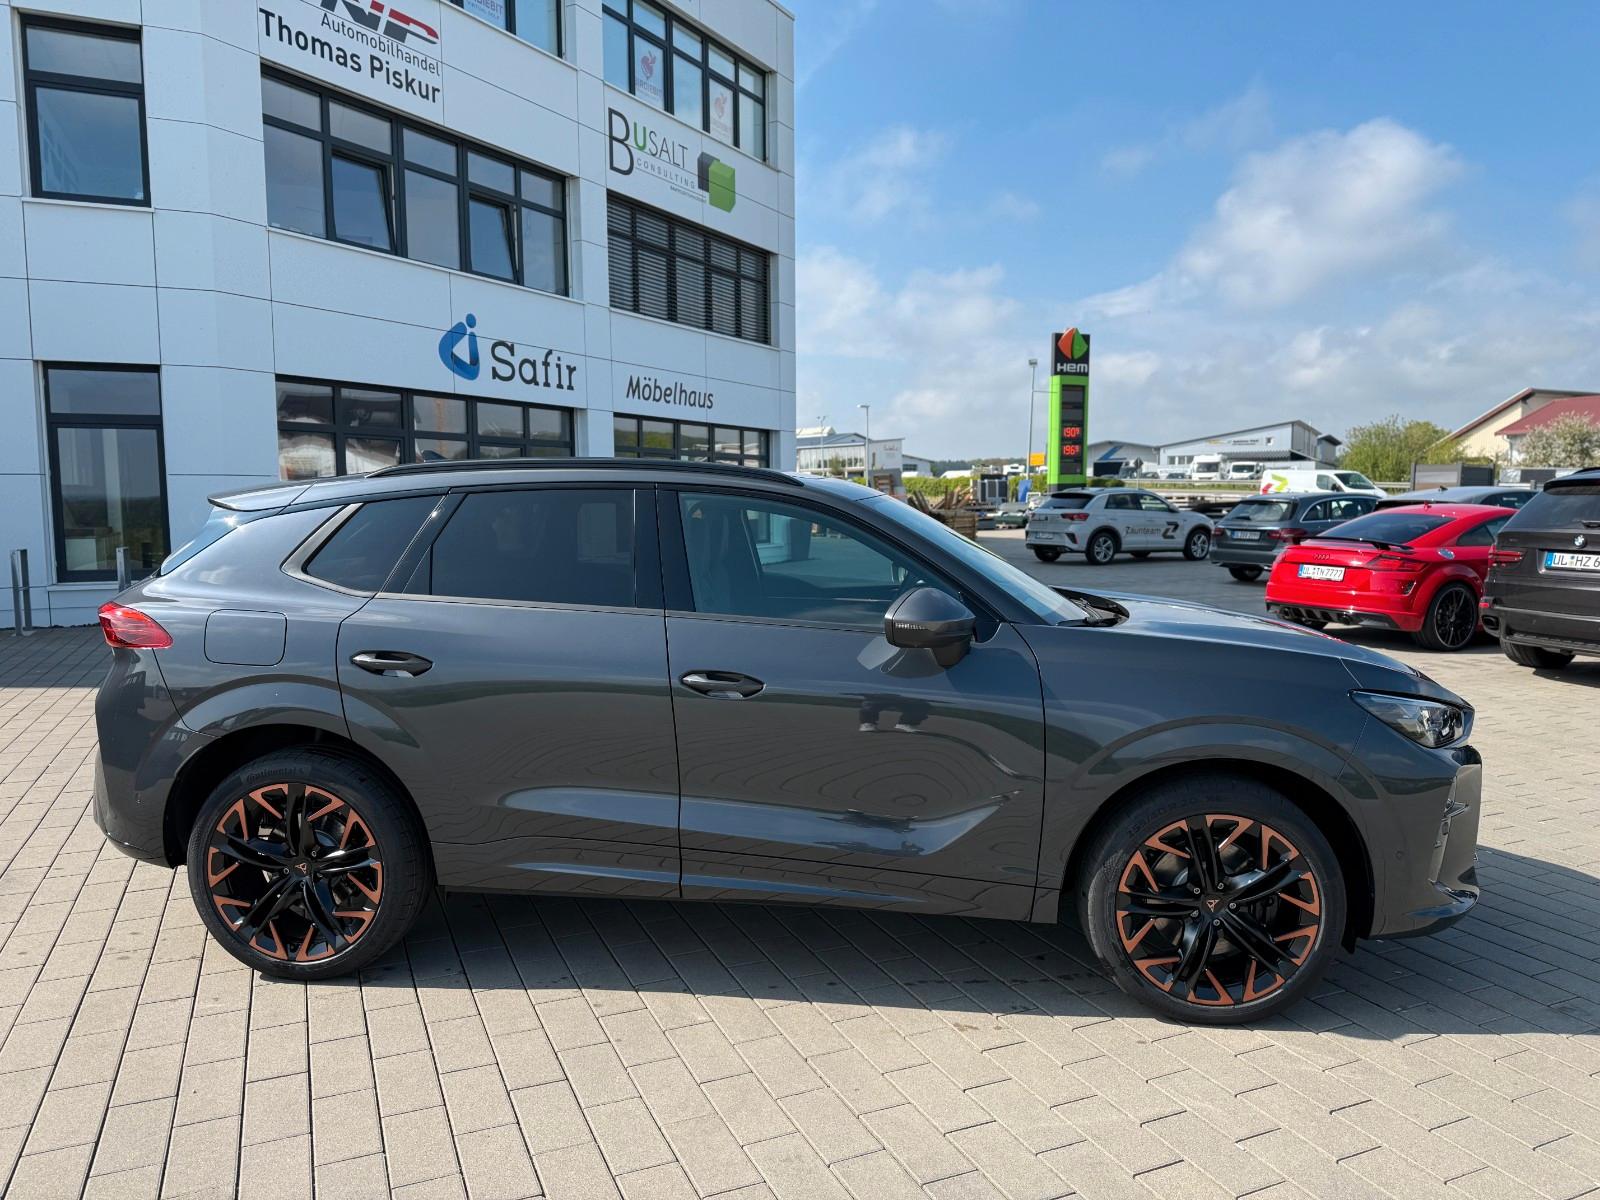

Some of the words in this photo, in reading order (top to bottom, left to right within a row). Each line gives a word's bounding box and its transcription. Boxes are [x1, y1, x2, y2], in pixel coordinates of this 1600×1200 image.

[258, 7, 362, 73] Thomas
[369, 54, 441, 103] Piskur
[320, 12, 441, 77] Automobilhandel
[636, 157, 696, 190] CONSULTING
[490, 340, 577, 391] Safir
[625, 374, 714, 410] Möbelhaus
